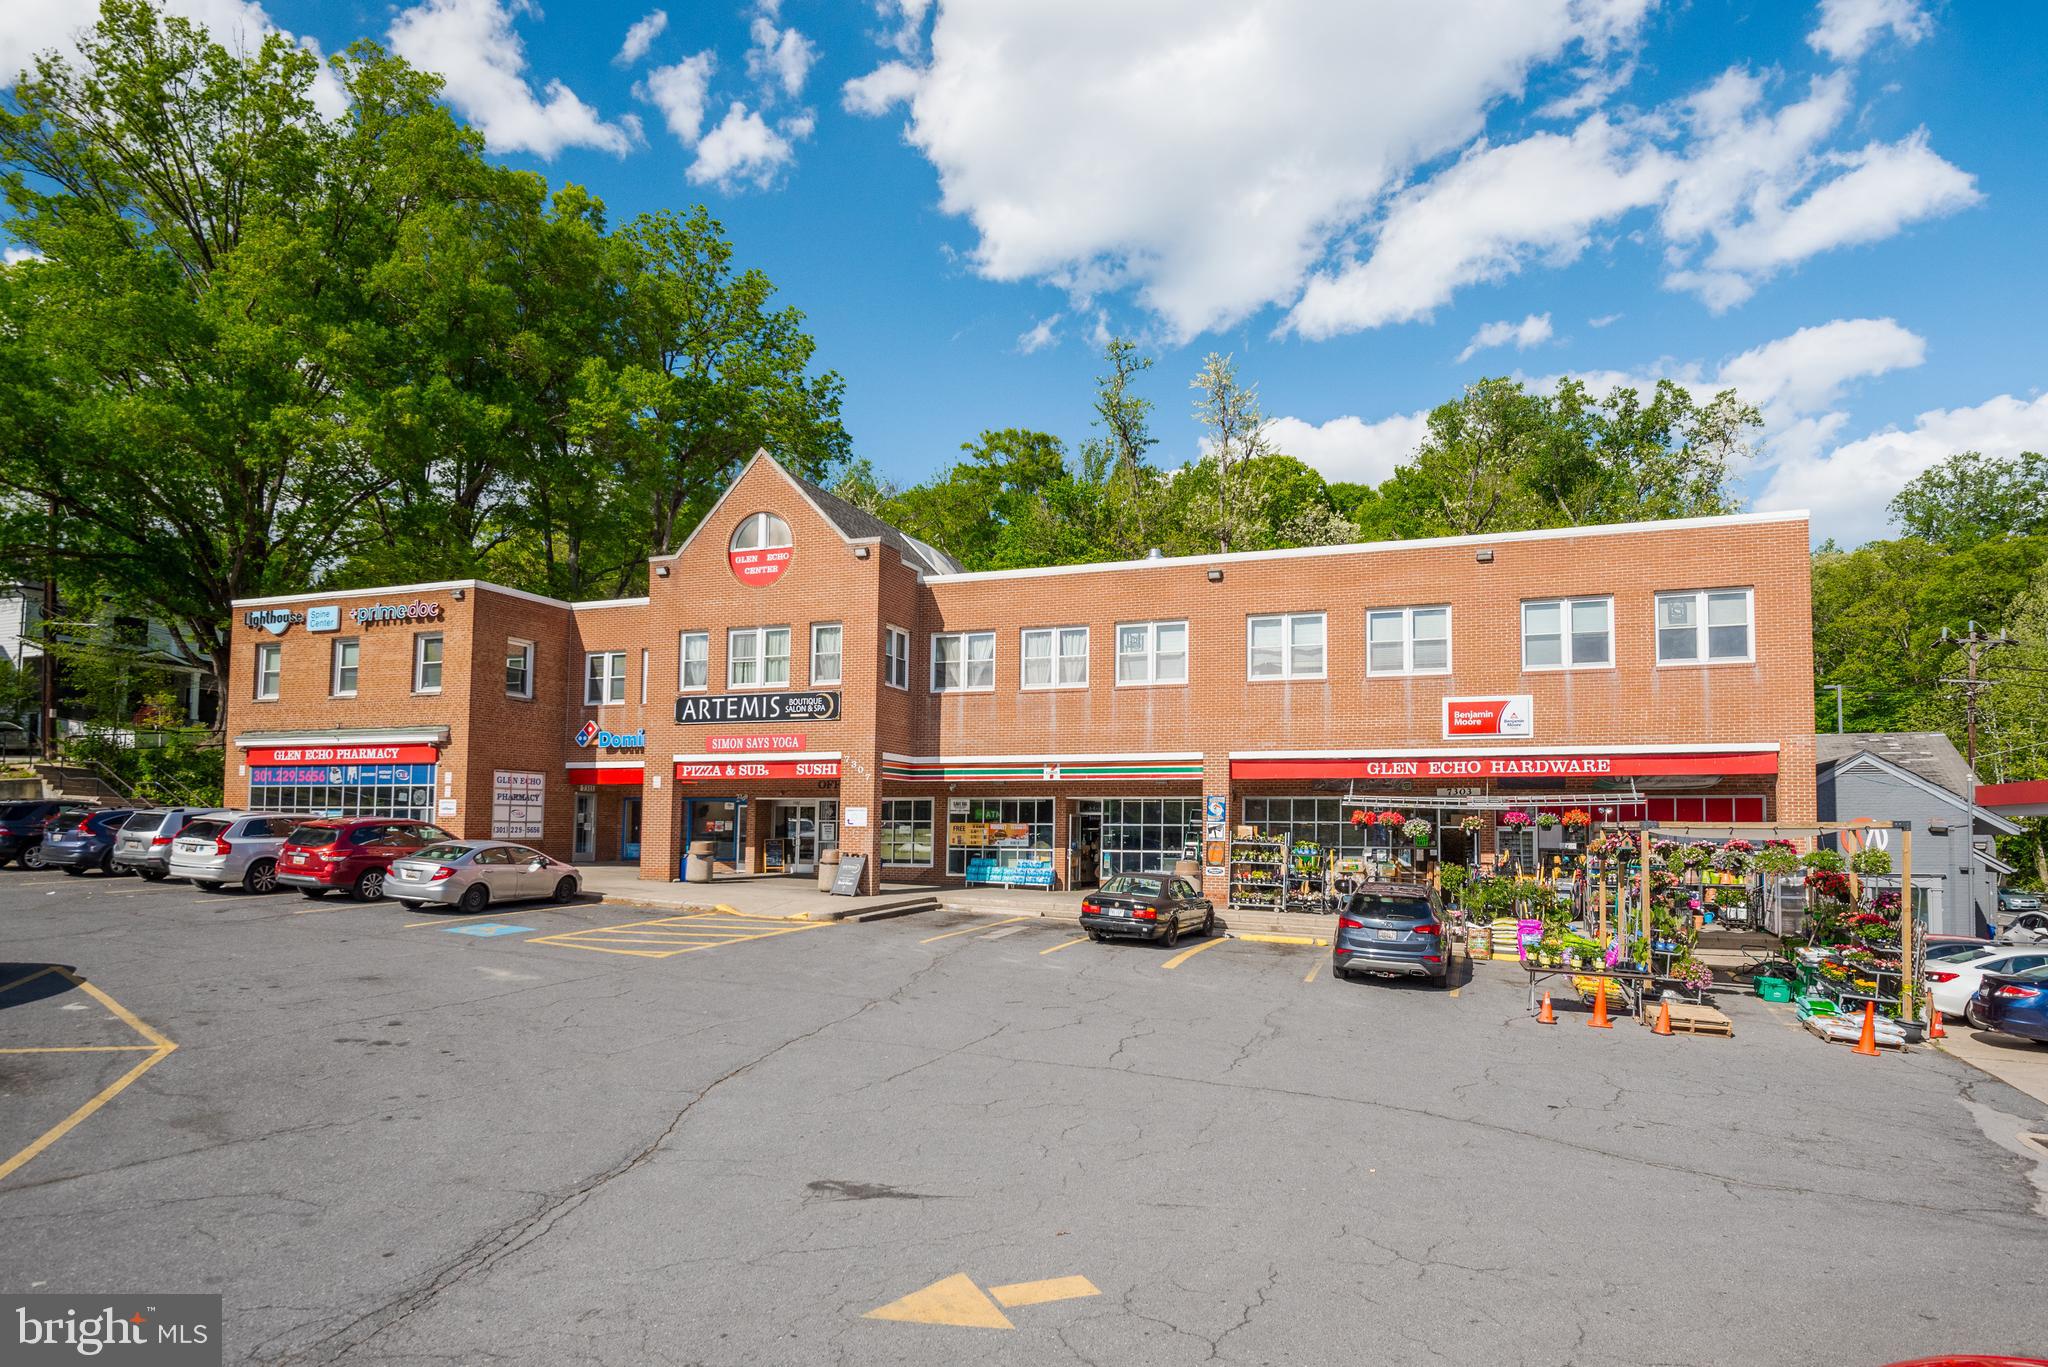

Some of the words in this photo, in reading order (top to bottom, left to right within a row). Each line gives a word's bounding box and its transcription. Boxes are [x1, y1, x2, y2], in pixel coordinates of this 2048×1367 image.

[735, 555, 758, 563] GLEN
[767, 553, 790, 561] ECHO
[744, 565, 778, 574] CENTER
[310, 609, 330, 620] Spine
[357, 600, 440, 624] primedoc
[244, 610, 303, 627] Lighthouse
[310, 618, 335, 628] Center
[788, 697, 823, 706] BOUTIQUE
[682, 695, 780, 720] ARTEMIS
[785, 704, 807, 713] SALON
[808, 704, 814, 712] &
[814, 703, 826, 712] SPA
[1454, 710, 1493, 719] Benjamin
[1454, 718, 1482, 726] Moore
[712, 737, 744, 750] SIMON
[746, 736, 770, 749] SAYS
[772, 736, 799, 749] YOGA
[273, 750, 301, 761] GLEN
[305, 749, 333, 760] ECHO
[336, 747, 400, 760] PHARMACY
[682, 764, 721, 777] PIZZA
[725, 765, 736, 776] &
[796, 763, 838, 776] SUSHI
[1366, 762, 1418, 776] GLEN
[1428, 761, 1482, 775] ECHO
[1490, 759, 1611, 775] HARDWARE
[496, 775, 519, 785] GLEN
[520, 777, 542, 786] ECHO
[496, 792, 540, 802] PHARMACY
[1447, 788, 1472, 796] 7303
